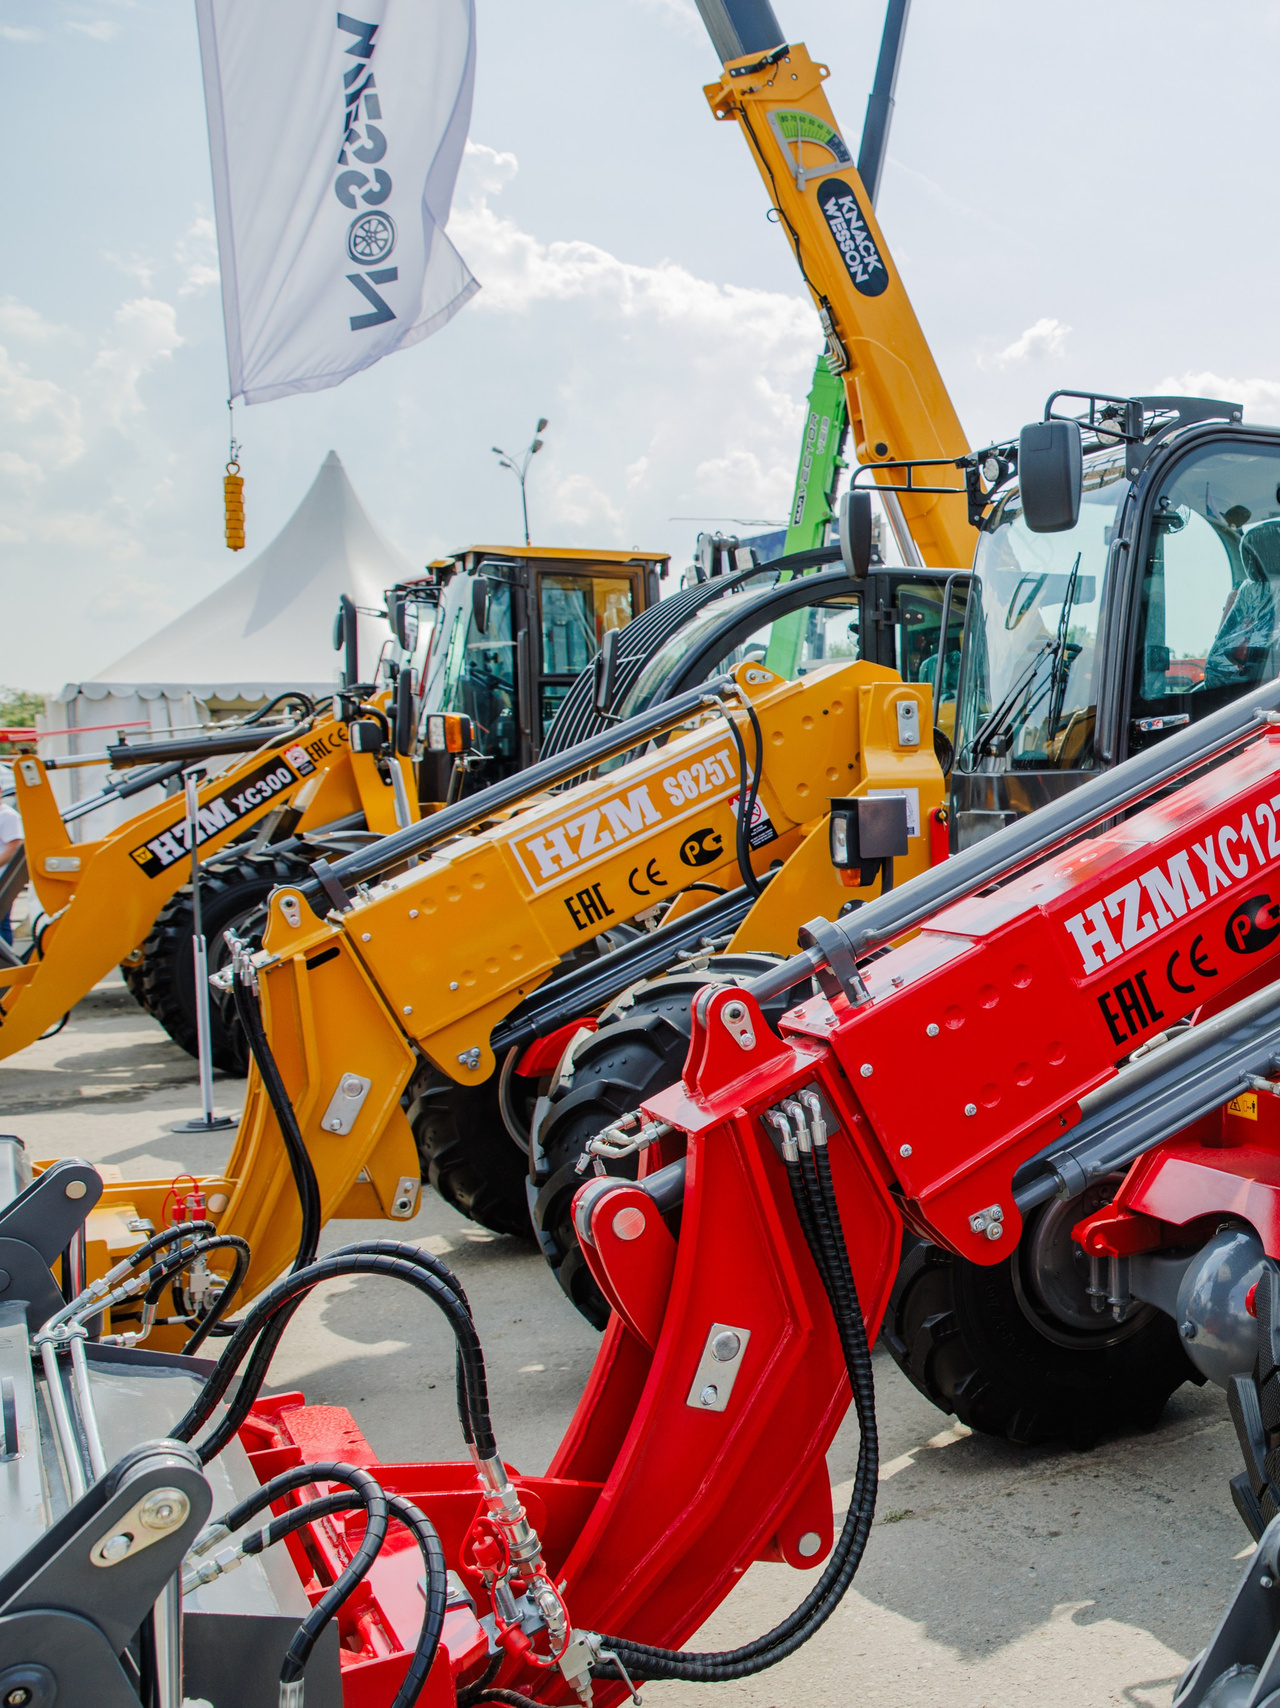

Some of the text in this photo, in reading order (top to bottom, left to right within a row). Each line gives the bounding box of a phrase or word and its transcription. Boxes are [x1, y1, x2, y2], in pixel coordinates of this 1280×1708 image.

[823, 196, 870, 283] WESSON
[838, 195, 883, 274] KNACK
[798, 412, 819, 495] VECTOR
[147, 767, 292, 866] HZM XC300
[526, 749, 736, 878] HZM S825T
[1064, 849, 1207, 975] HZM
